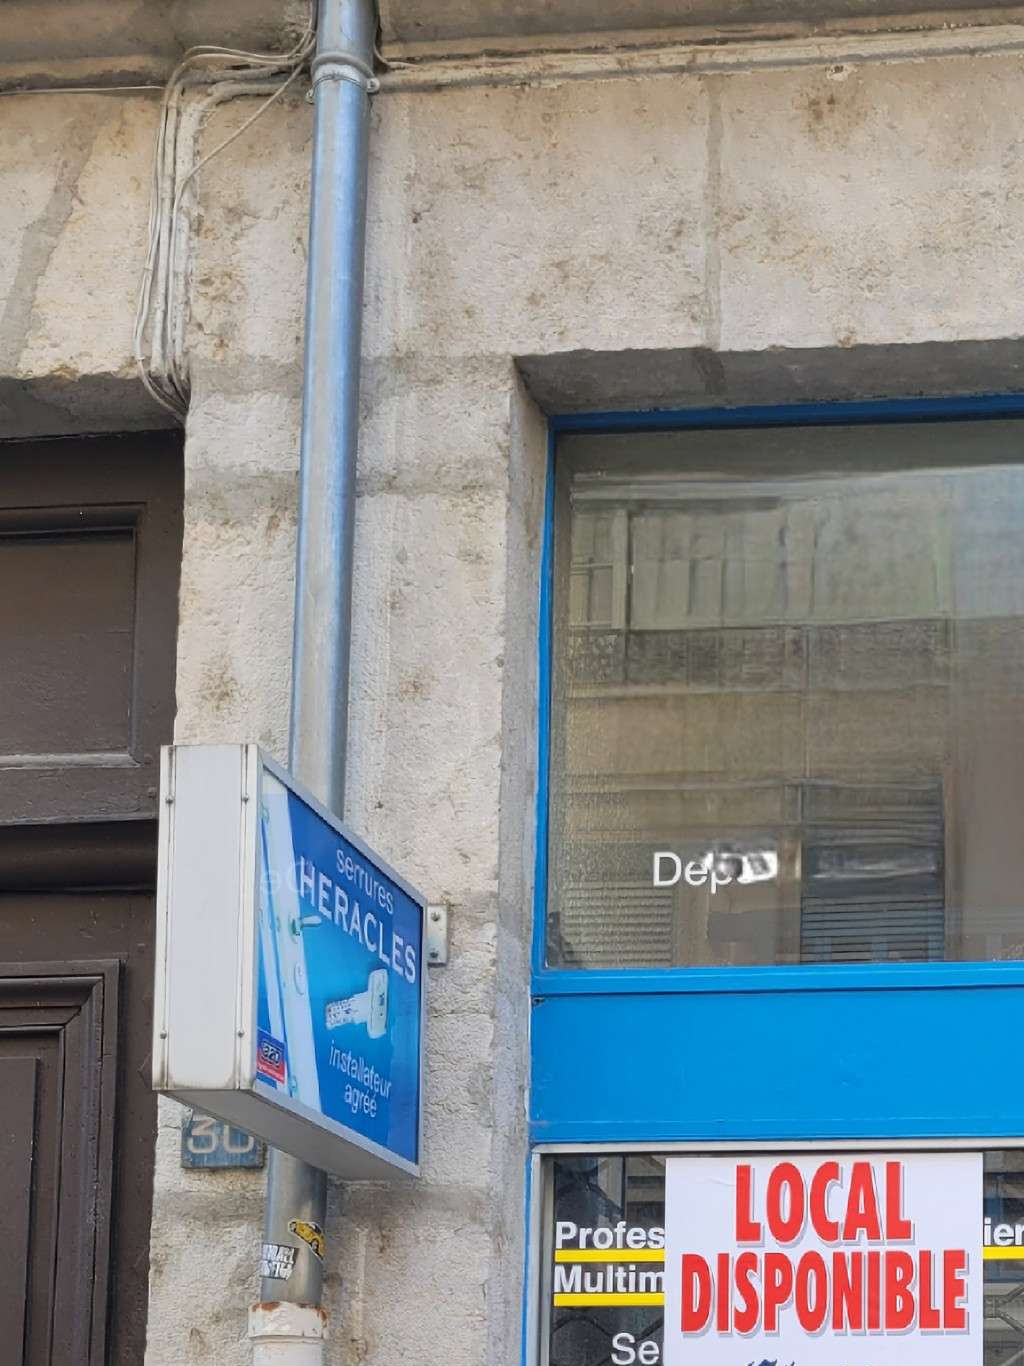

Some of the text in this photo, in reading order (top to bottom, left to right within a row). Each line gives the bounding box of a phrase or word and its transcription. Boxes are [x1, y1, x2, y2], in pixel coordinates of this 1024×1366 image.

[335, 850, 394, 915] serrures
[300, 856, 416, 984] HERACLES
[329, 1040, 392, 1100] installateur
[344, 1082, 377, 1118] agréé
[736, 1161, 912, 1243] LOCAL
[555, 1221, 664, 1250] Profes
[554, 1264, 665, 1293] Multim
[681, 1249, 968, 1333] DISPONIBLE
